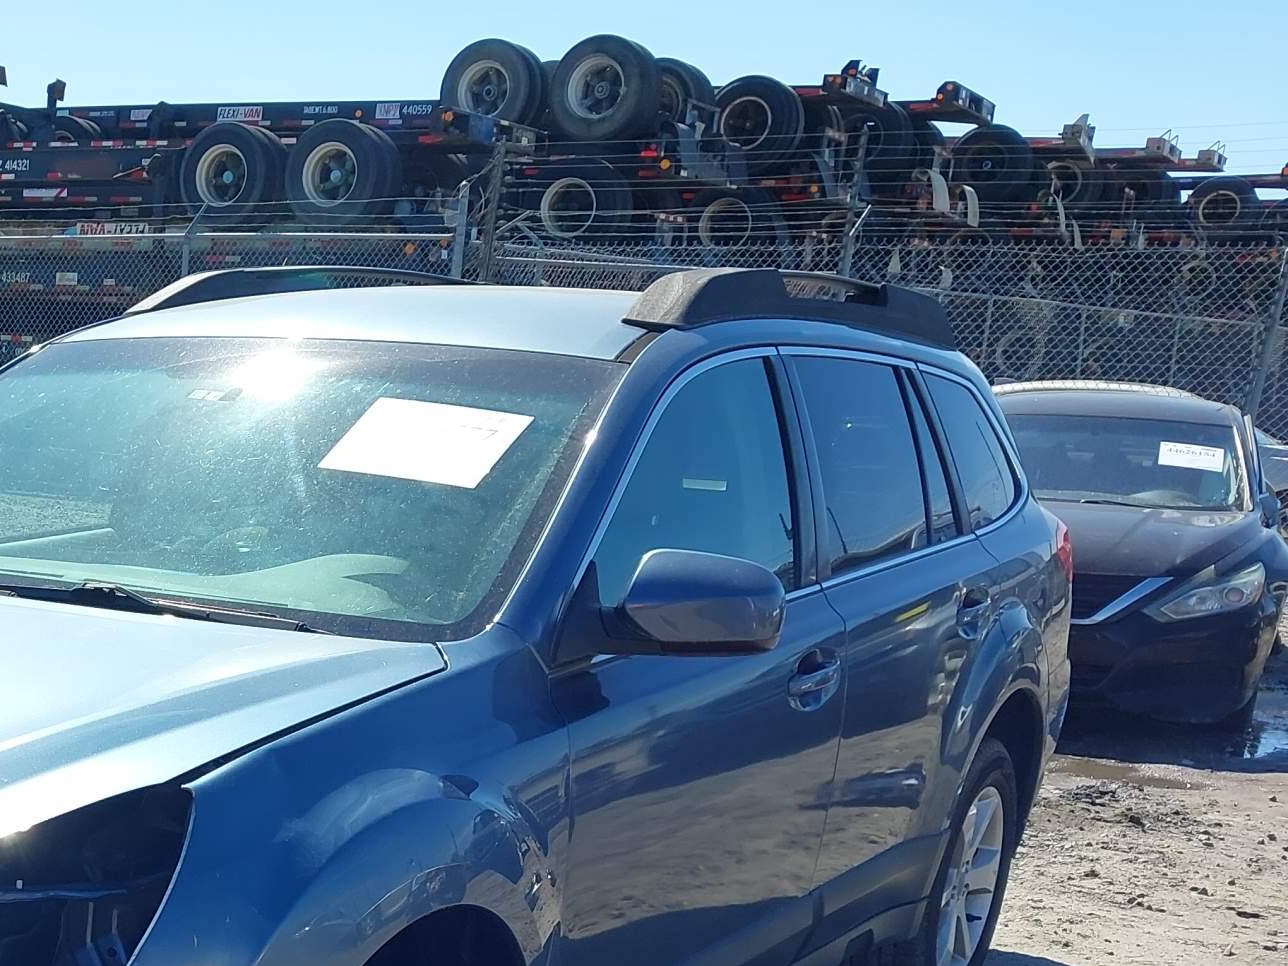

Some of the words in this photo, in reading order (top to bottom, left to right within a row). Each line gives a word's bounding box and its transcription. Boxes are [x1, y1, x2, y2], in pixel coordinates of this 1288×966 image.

[218, 107, 262, 121] FLEXI-VAN
[402, 104, 433, 116] 440559
[5, 159, 30, 171] 414321
